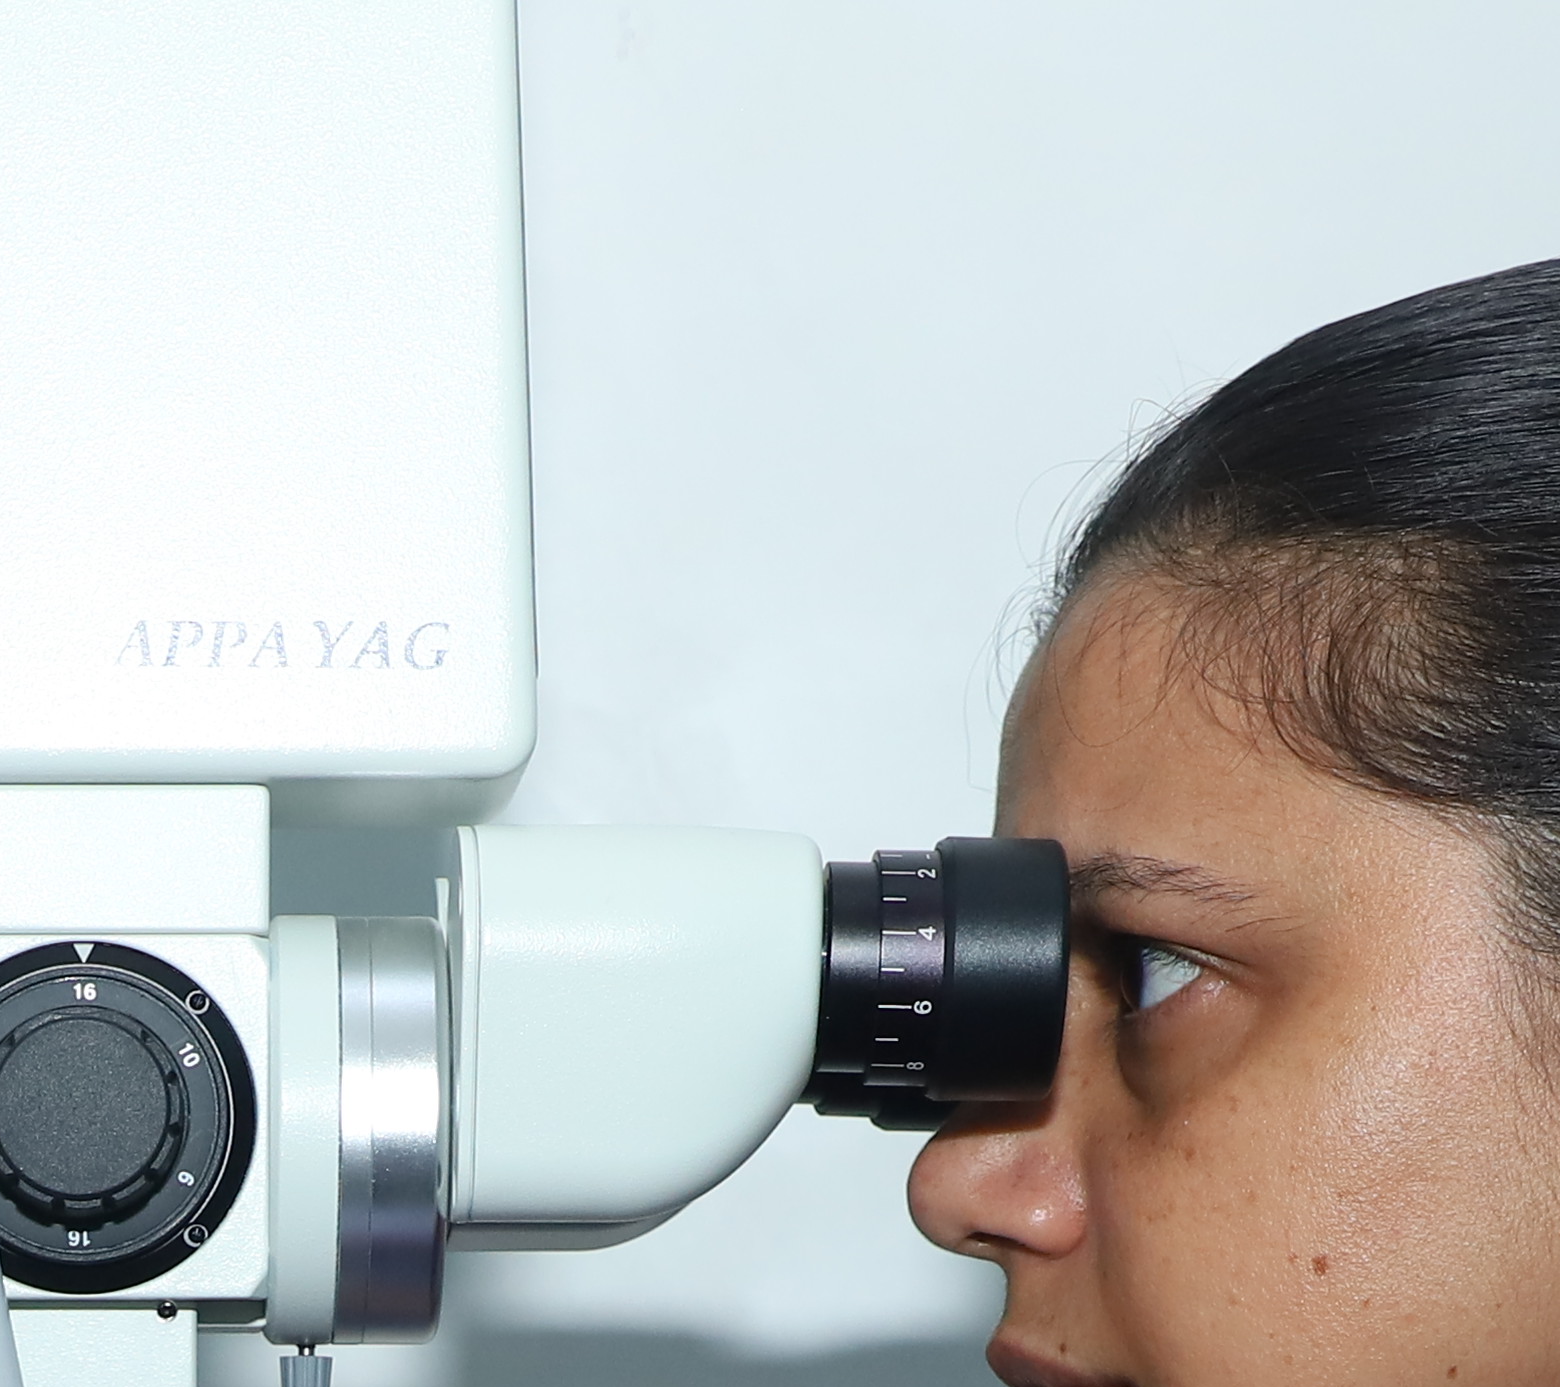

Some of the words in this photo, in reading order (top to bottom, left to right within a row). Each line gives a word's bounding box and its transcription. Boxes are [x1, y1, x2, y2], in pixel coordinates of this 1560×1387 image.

[114, 619, 290, 668] APPA
[313, 619, 451, 670] YAG
[916, 867, 937, 880] 2
[916, 924, 937, 942] 4
[72, 982, 97, 1001] 16
[176, 1042, 200, 1069] 10
